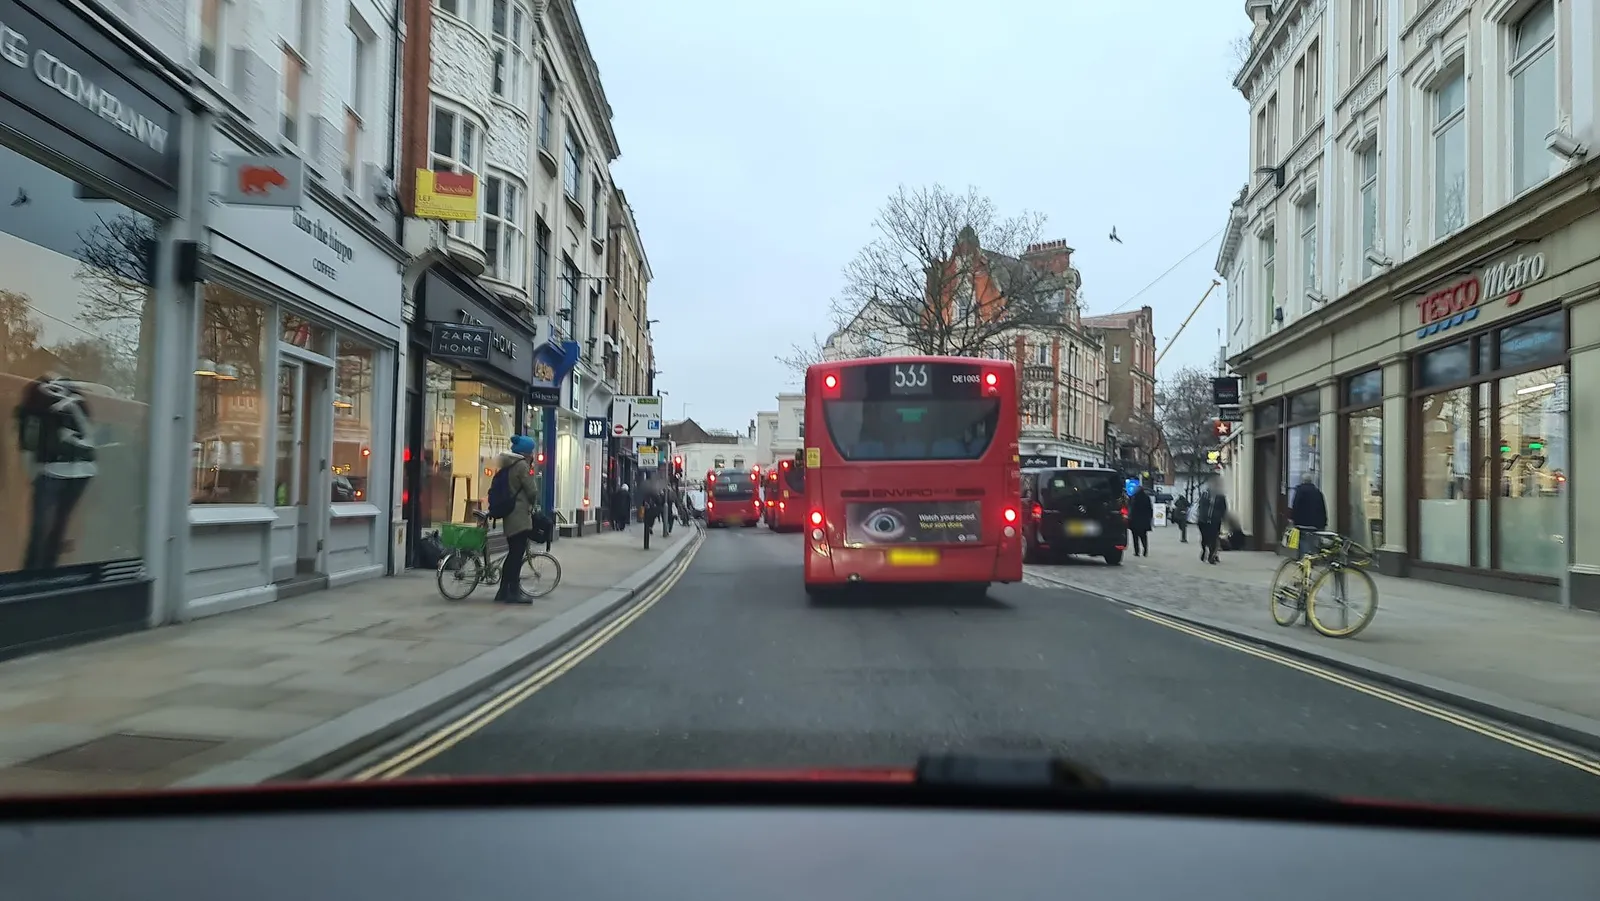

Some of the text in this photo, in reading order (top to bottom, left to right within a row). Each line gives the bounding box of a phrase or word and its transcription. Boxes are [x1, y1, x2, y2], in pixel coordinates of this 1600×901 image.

[33, 49, 168, 154] COMPANY
[313, 218, 328, 245] the
[328, 227, 353, 264] hippo
[313, 257, 337, 281] COFFEE
[1416, 252, 1545, 324] TESCO Metro
[441, 330, 484, 343] ZARA
[439, 343, 482, 355] HOME
[895, 364, 928, 387] 533
[589, 420, 602, 435] GAP
[872, 488, 933, 497] ENVIRO
[918, 513, 939, 522] Watch
[940, 514, 955, 522] your
[920, 521, 934, 529] Your
